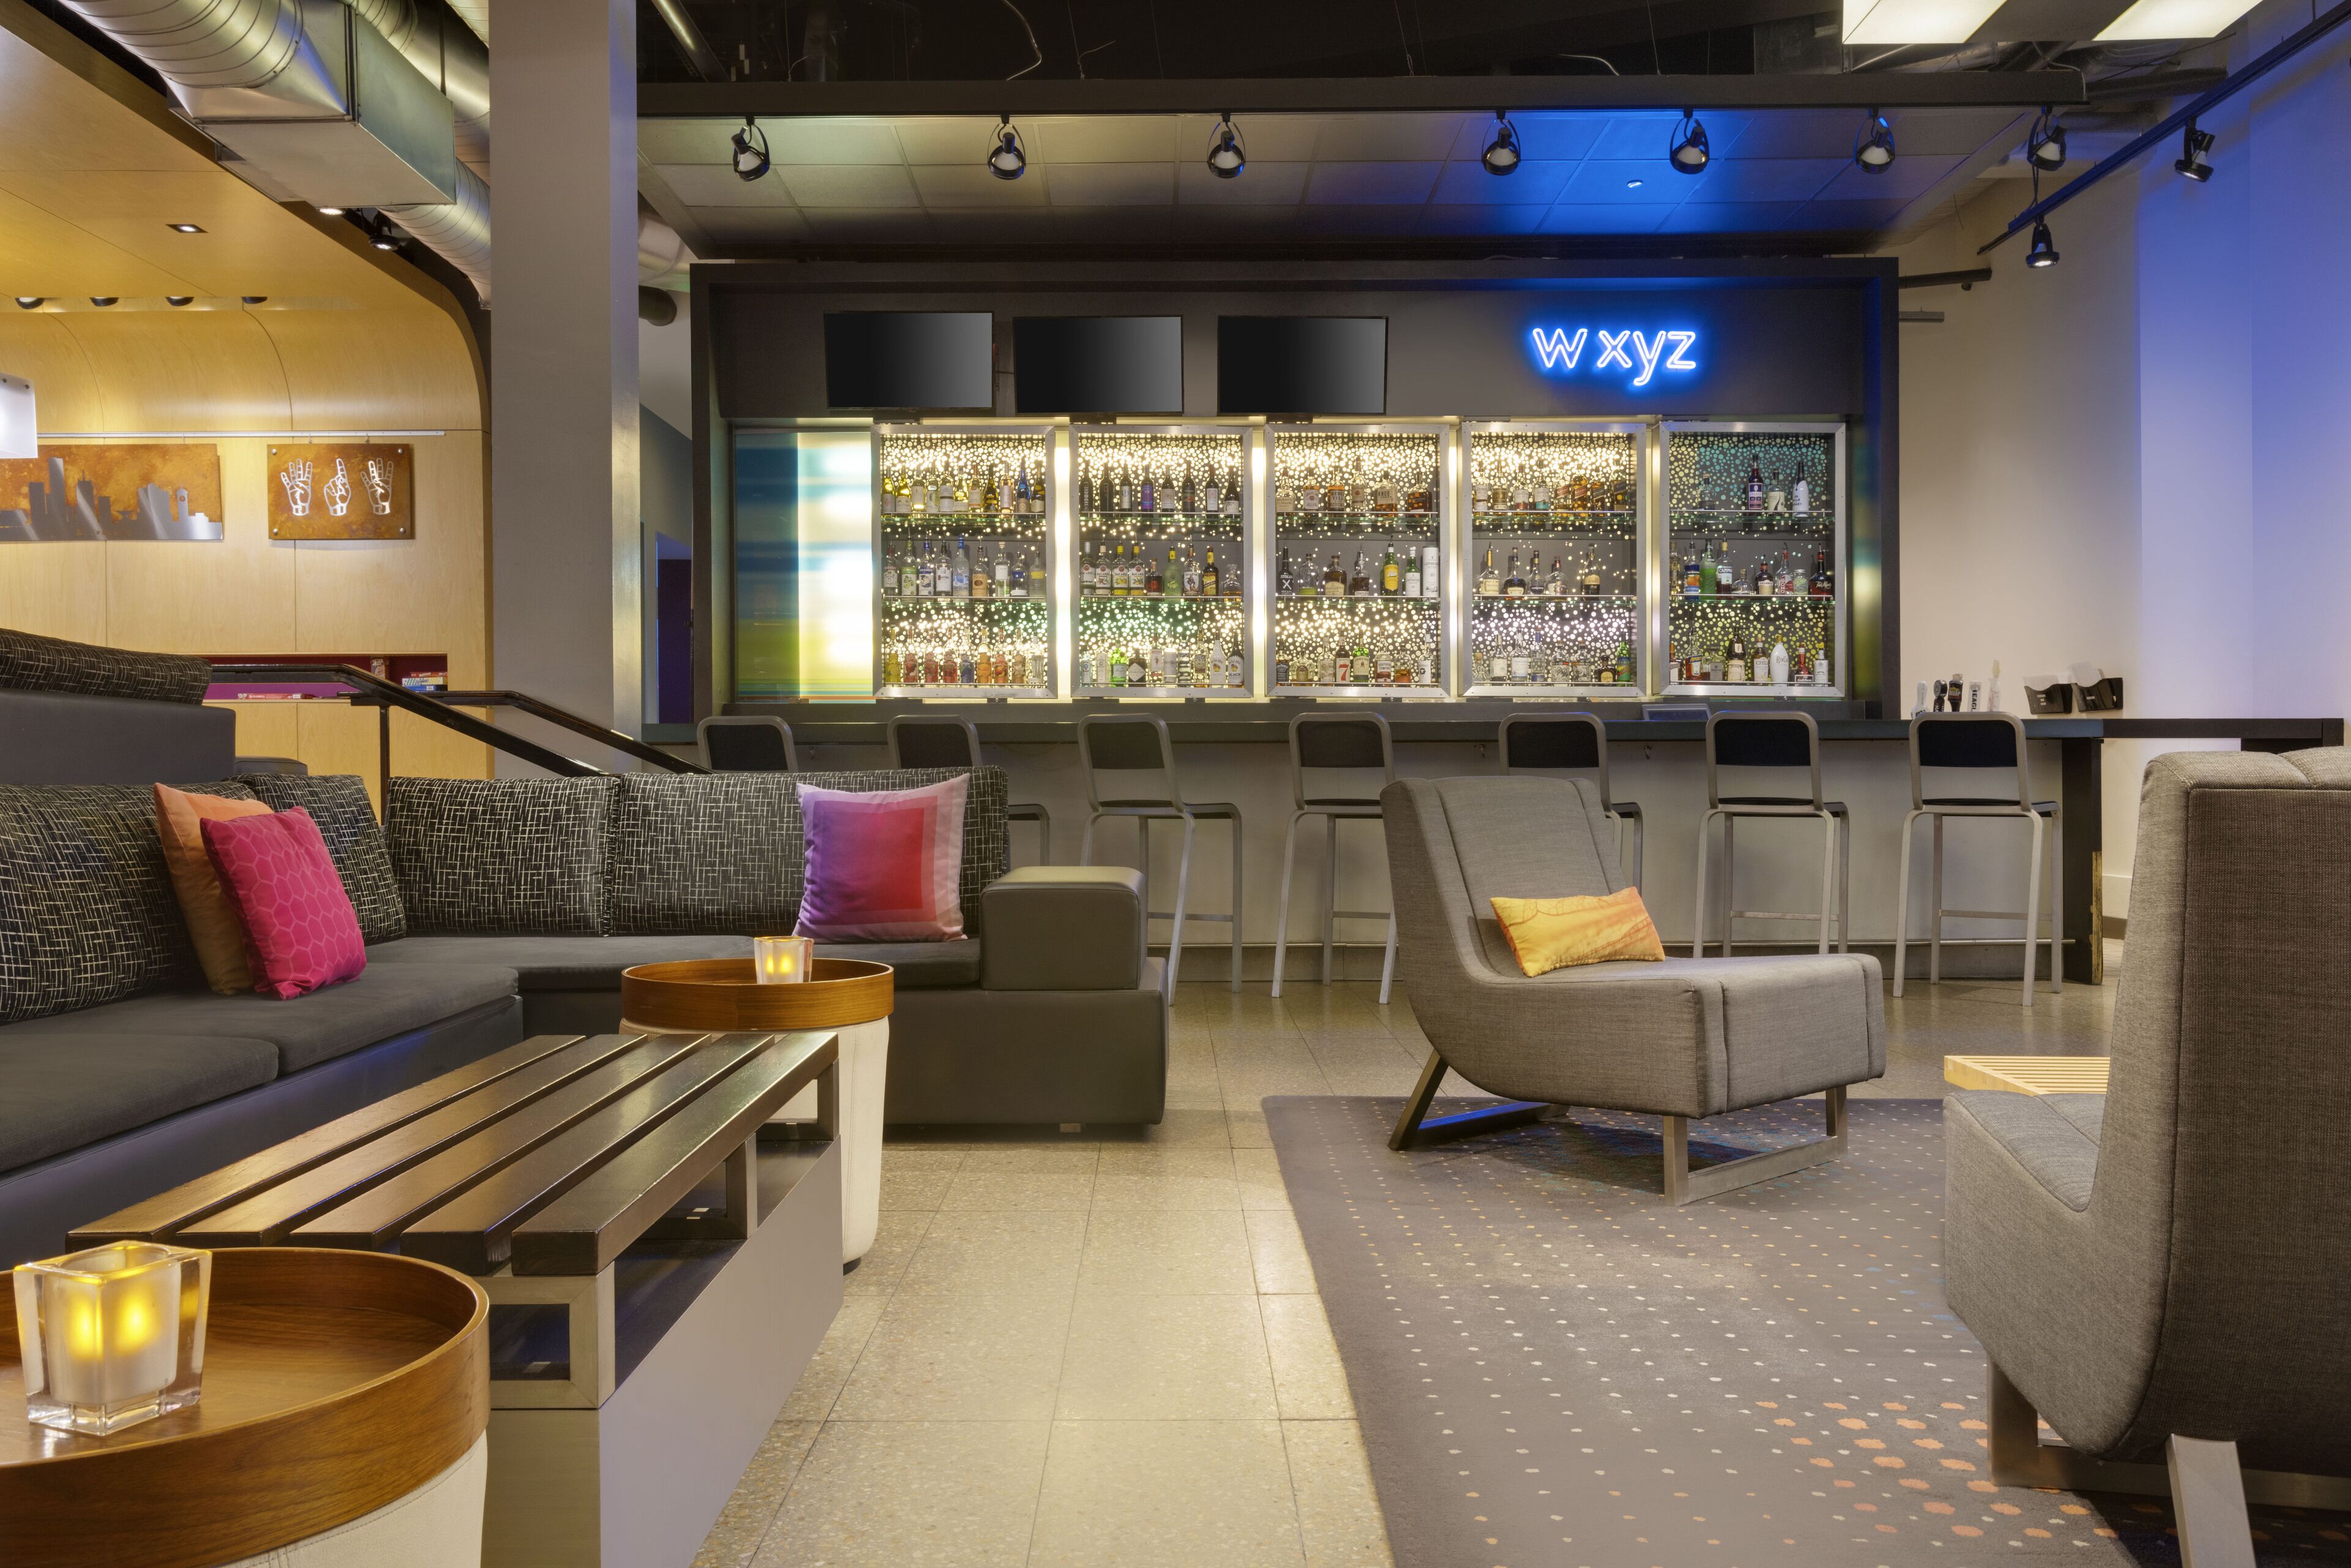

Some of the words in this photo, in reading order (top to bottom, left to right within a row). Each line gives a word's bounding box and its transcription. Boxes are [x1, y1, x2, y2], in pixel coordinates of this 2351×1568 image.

[1597, 331, 1696, 386] xyz
[1282, 579, 1292, 590] X
[1338, 664, 1349, 681] 7
